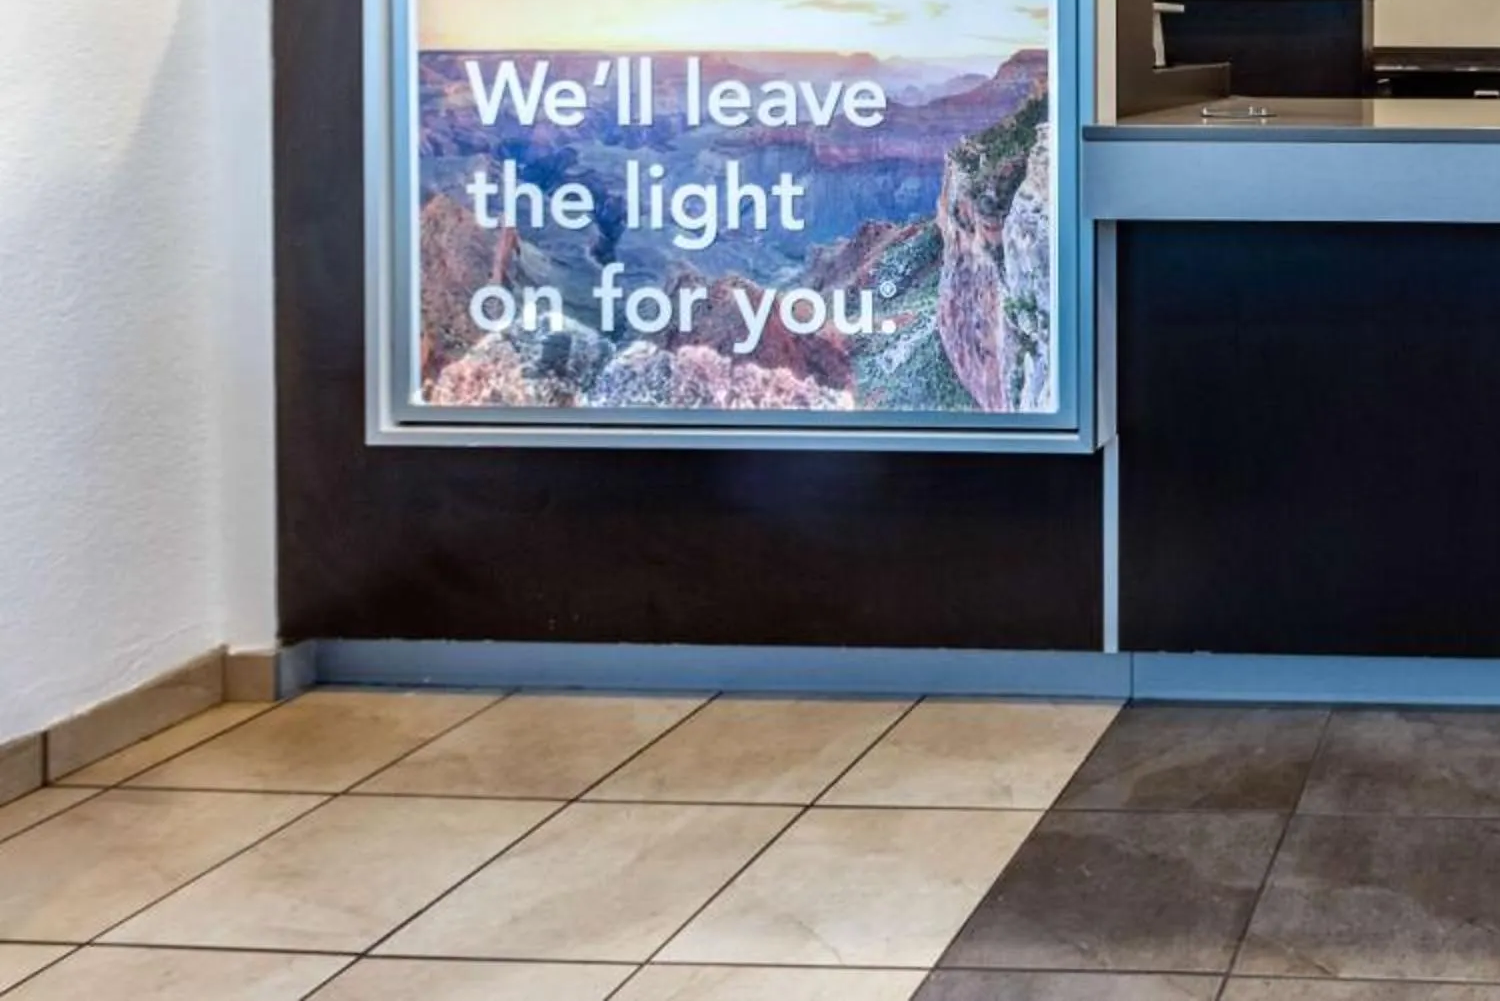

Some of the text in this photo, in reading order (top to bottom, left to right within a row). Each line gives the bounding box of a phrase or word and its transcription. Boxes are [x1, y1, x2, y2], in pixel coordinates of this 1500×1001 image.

[686, 55, 888, 127] leave
[466, 159, 806, 250] the light
[468, 282, 564, 333] on
[592, 262, 708, 333] for
